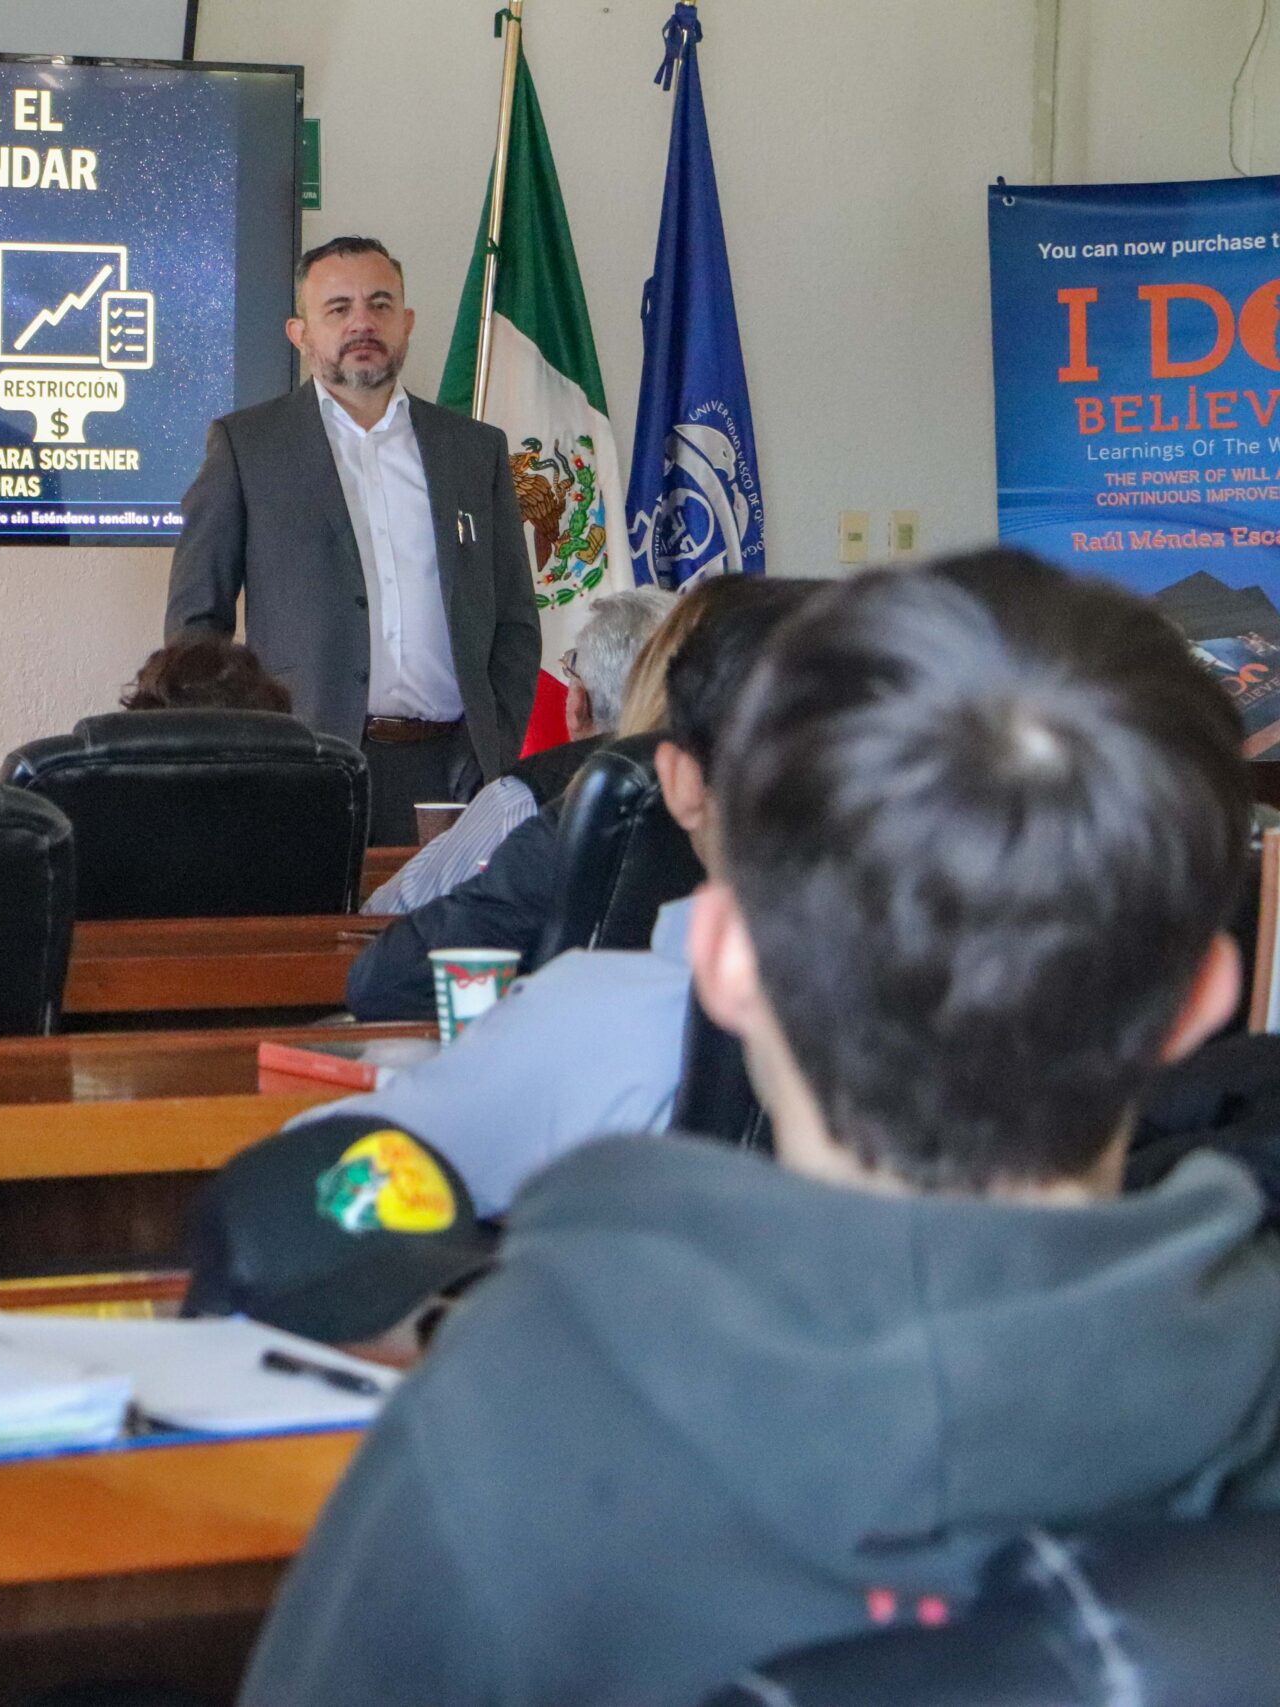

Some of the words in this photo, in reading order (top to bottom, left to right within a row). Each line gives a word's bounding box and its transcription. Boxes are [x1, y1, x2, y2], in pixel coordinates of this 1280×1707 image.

[14, 88, 64, 132] EL
[1038, 242, 1076, 259] You
[1082, 242, 1118, 258] can
[1124, 241, 1166, 256] now
[1172, 234, 1266, 258] purchase
[1057, 287, 1099, 383] I
[4, 377, 118, 399] RESTRICCIÓN
[50, 408, 70, 440] $
[688, 400, 740, 450] UNIVERSIDAD
[39, 449, 139, 471] SOSTENER
[1087, 442, 1185, 461] Learnings
[1192, 439, 1215, 457] Of
[1223, 437, 1260, 456] The
[736, 452, 753, 490] VASCO
[1104, 472, 1136, 487] THE
[1142, 470, 1200, 485] POWER
[1205, 468, 1226, 483] OF
[1232, 467, 1270, 481] WILL
[748, 492, 760, 508] DE
[1096, 490, 1201, 506] CONTINUOUS
[1206, 486, 1280, 503] IMPROVE
[10, 511, 28, 524] sin
[31, 510, 95, 524] Estándares
[98, 511, 149, 525] sencillos
[151, 515, 160, 528] y
[1072, 531, 1124, 552] Raúl
[1128, 529, 1225, 550] Méndez
